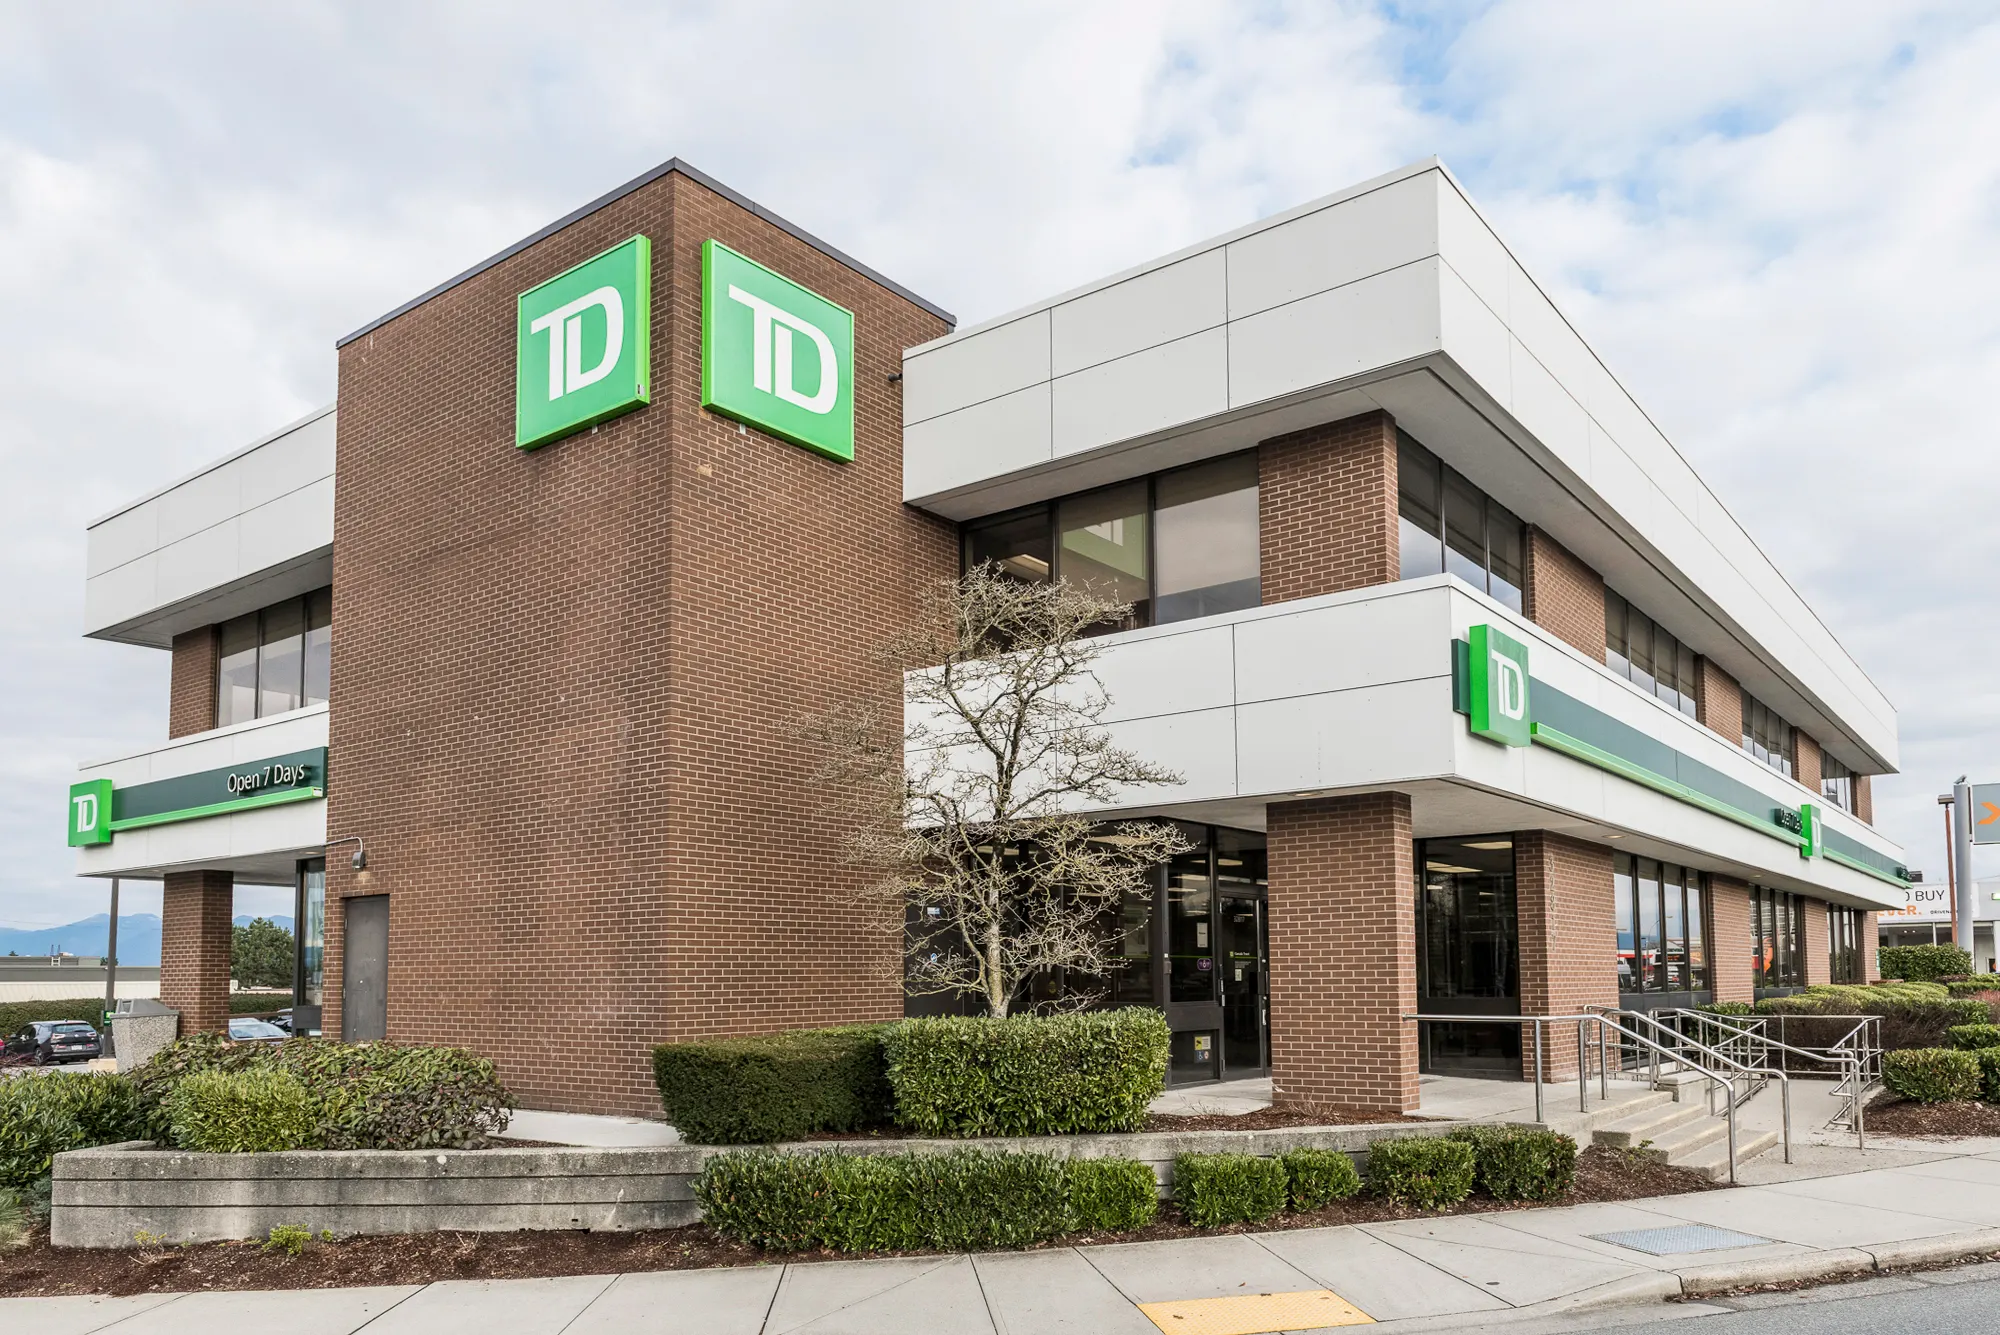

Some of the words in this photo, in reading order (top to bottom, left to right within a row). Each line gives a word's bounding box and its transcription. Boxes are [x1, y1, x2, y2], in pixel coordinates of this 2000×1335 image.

[531, 285, 624, 401] TD
[728, 283, 839, 415] TD
[1491, 648, 1524, 720] TD
[227, 772, 260, 796] Open
[263, 765, 271, 786] 7
[273, 763, 305, 787] Days
[73, 793, 98, 833] TD
[1915, 890, 1944, 901] BUY
